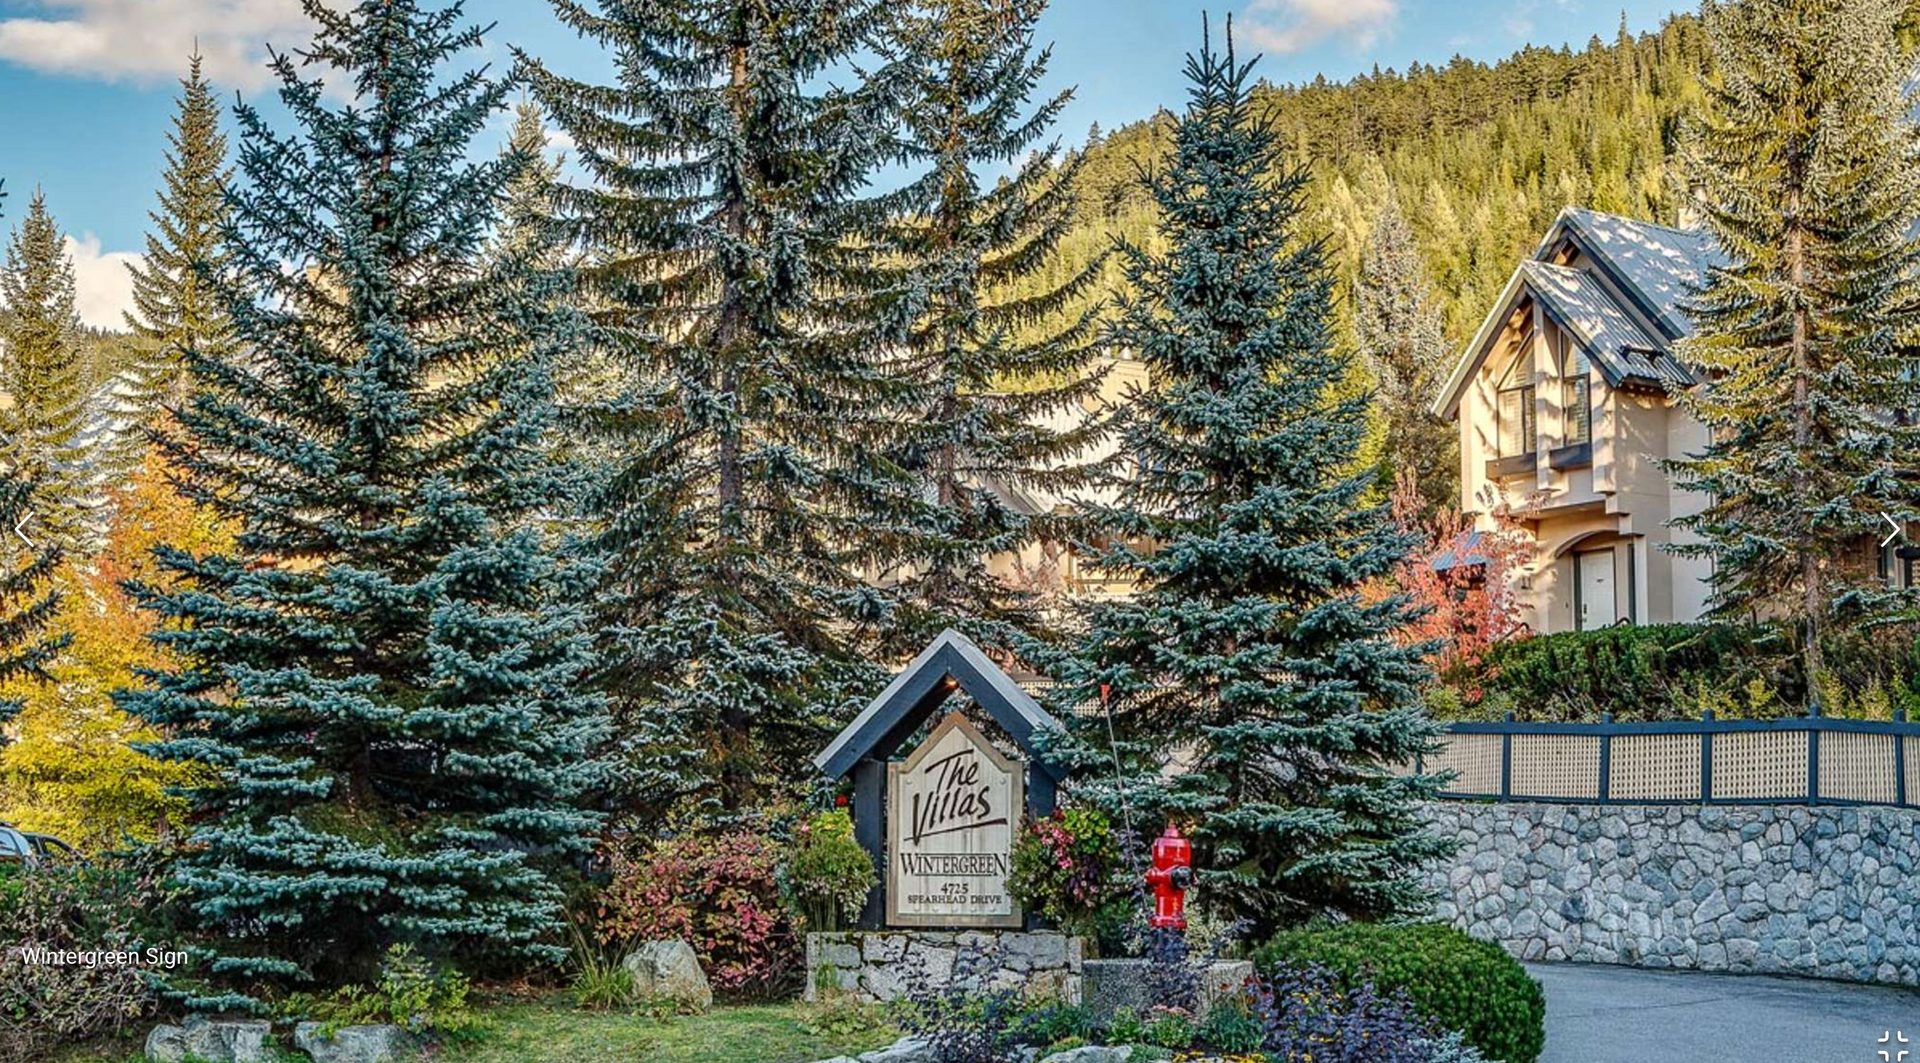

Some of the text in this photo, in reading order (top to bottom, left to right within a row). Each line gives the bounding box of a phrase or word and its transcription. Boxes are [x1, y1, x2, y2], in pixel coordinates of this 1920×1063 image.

[924, 749, 979, 794] The
[912, 786, 991, 846] Villas
[900, 853, 1007, 876] WINTERGREEN
[907, 895, 1002, 904] SPEARHEAD DRIVE
[940, 882, 969, 894] 4725
